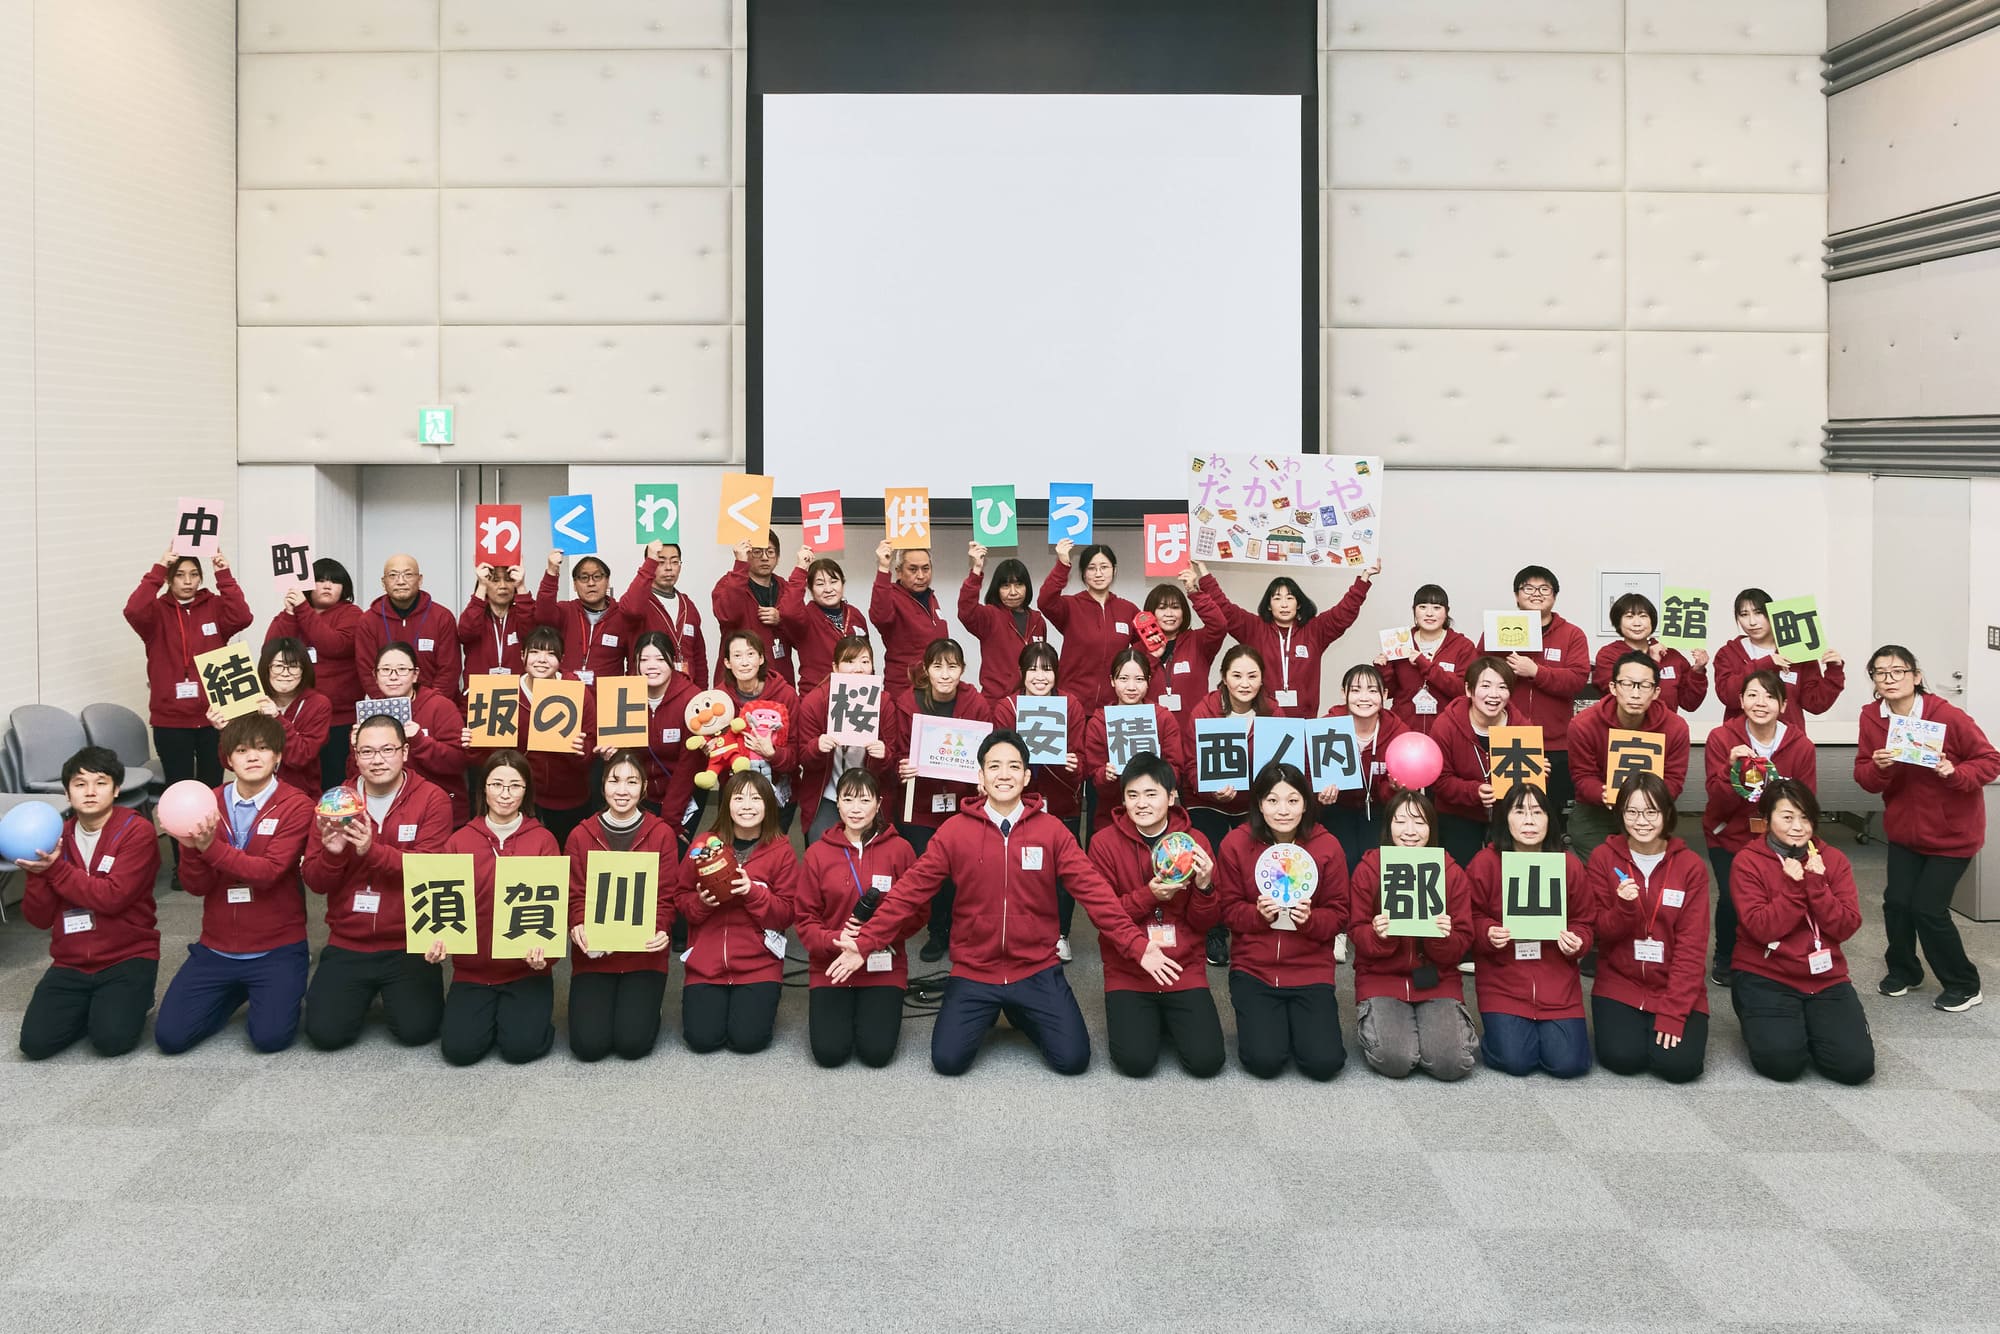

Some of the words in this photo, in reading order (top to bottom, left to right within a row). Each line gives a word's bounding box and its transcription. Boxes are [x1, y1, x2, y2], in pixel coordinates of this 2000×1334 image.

[1197, 467, 1363, 510] だがしや
[179, 506, 219, 547] 中
[479, 516, 520, 554] わ
[555, 503, 590, 543] く
[637, 494, 678, 532] わ
[727, 493, 760, 533] く
[802, 502, 842, 545] 子
[886, 495, 928, 538] 供
[976, 499, 1014, 534] ひ
[1051, 496, 1088, 540] ろ
[271, 543, 310, 581] 町
[1147, 523, 1188, 564] ば
[1662, 595, 1709, 639] 舘
[1773, 610, 1820, 651] 町
[203, 654, 260, 707] 結
[468, 688, 518, 736] 坂
[533, 695, 578, 738] の
[598, 687, 646, 737] 上
[830, 683, 880, 733] 桜
[1017, 706, 1066, 756] 安
[1106, 717, 1157, 765] 積
[1198, 732, 1247, 781] 西
[1311, 728, 1357, 778] 内
[1491, 738, 1543, 788] 本
[1609, 736, 1663, 789] 宮
[411, 879, 468, 935] 須
[503, 882, 560, 941] 賀
[594, 871, 646, 926] 川
[1383, 862, 1444, 920] 郡
[1506, 865, 1562, 917] 山
